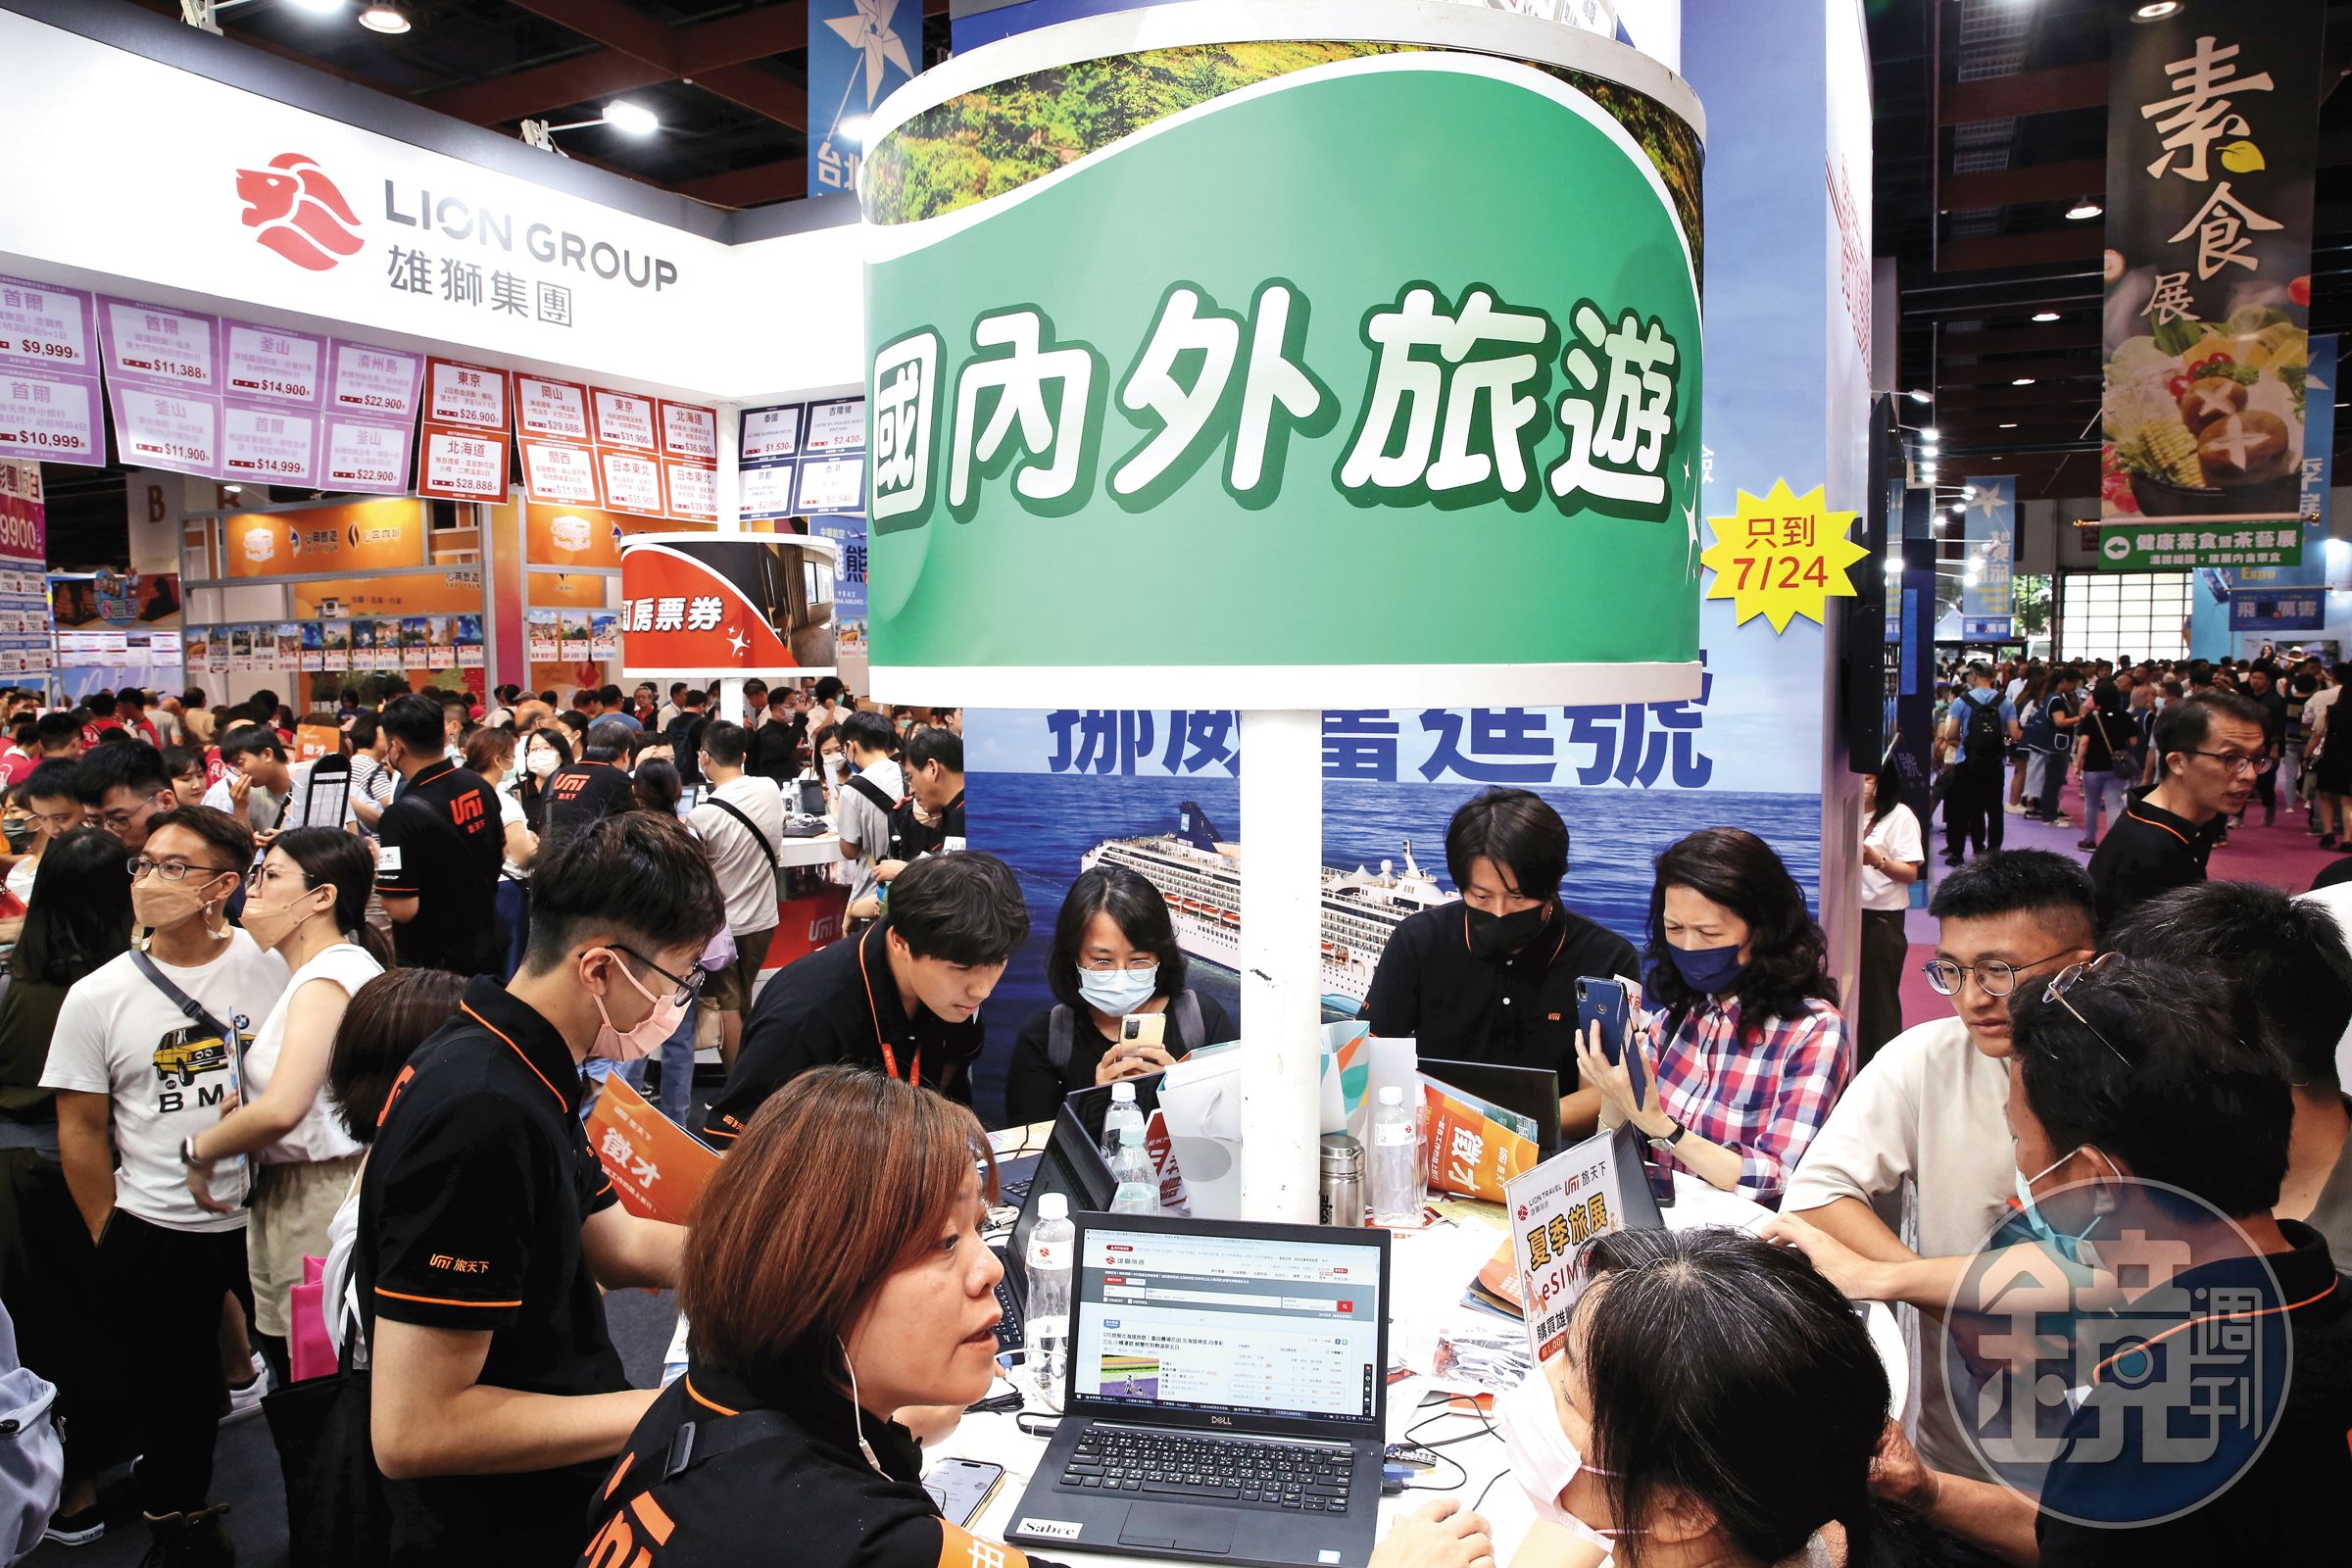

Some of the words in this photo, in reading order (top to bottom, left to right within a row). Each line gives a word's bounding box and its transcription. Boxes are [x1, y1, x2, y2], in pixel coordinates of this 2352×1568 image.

[2139, 35, 2284, 325] 素食展
[385, 179, 512, 252] LION
[526, 223, 678, 292] GROUP
[387, 244, 572, 328] 雄獅集團
[3, 288, 43, 312] 首爾
[145, 315, 179, 335] 首爾
[260, 336, 290, 356] 釜山
[357, 354, 398, 373] 濟州島
[457, 371, 481, 388] 東京
[10, 381, 52, 404] 首爾
[541, 386, 563, 401] 岡山
[155, 399, 187, 419] 釜山
[614, 399, 633, 414] 東京
[872, 279, 1680, 530] 國內外旅遊
[255, 416, 284, 434] 首爾
[460, 409, 496, 422] $26,900
[676, 410, 703, 426] 北海道
[357, 430, 381, 446] 釜山
[447, 440, 486, 458] 北海道
[612, 461, 650, 476] 日本東北
[677, 469, 711, 484] 日本東北
[456, 478, 493, 491] $28,888
[147, 484, 166, 523] B
[1745, 514, 1815, 550] 只到
[1733, 556, 1829, 591] 7/24
[601, 1127, 662, 1189] 徵才
[1448, 1126, 1484, 1192] 徵才
[1528, 1193, 1542, 1207] LION
[1542, 1184, 1562, 1200] TRAVEL
[1581, 1160, 1606, 1187] 旅天下
[1527, 1192, 1608, 1272] 夏季旅展
[1537, 1307, 1568, 1343] 購買雄
[1542, 1335, 1568, 1358] 前1,000
[1211, 1416, 1232, 1426] DELL
[1024, 1521, 1075, 1537] Sabre
